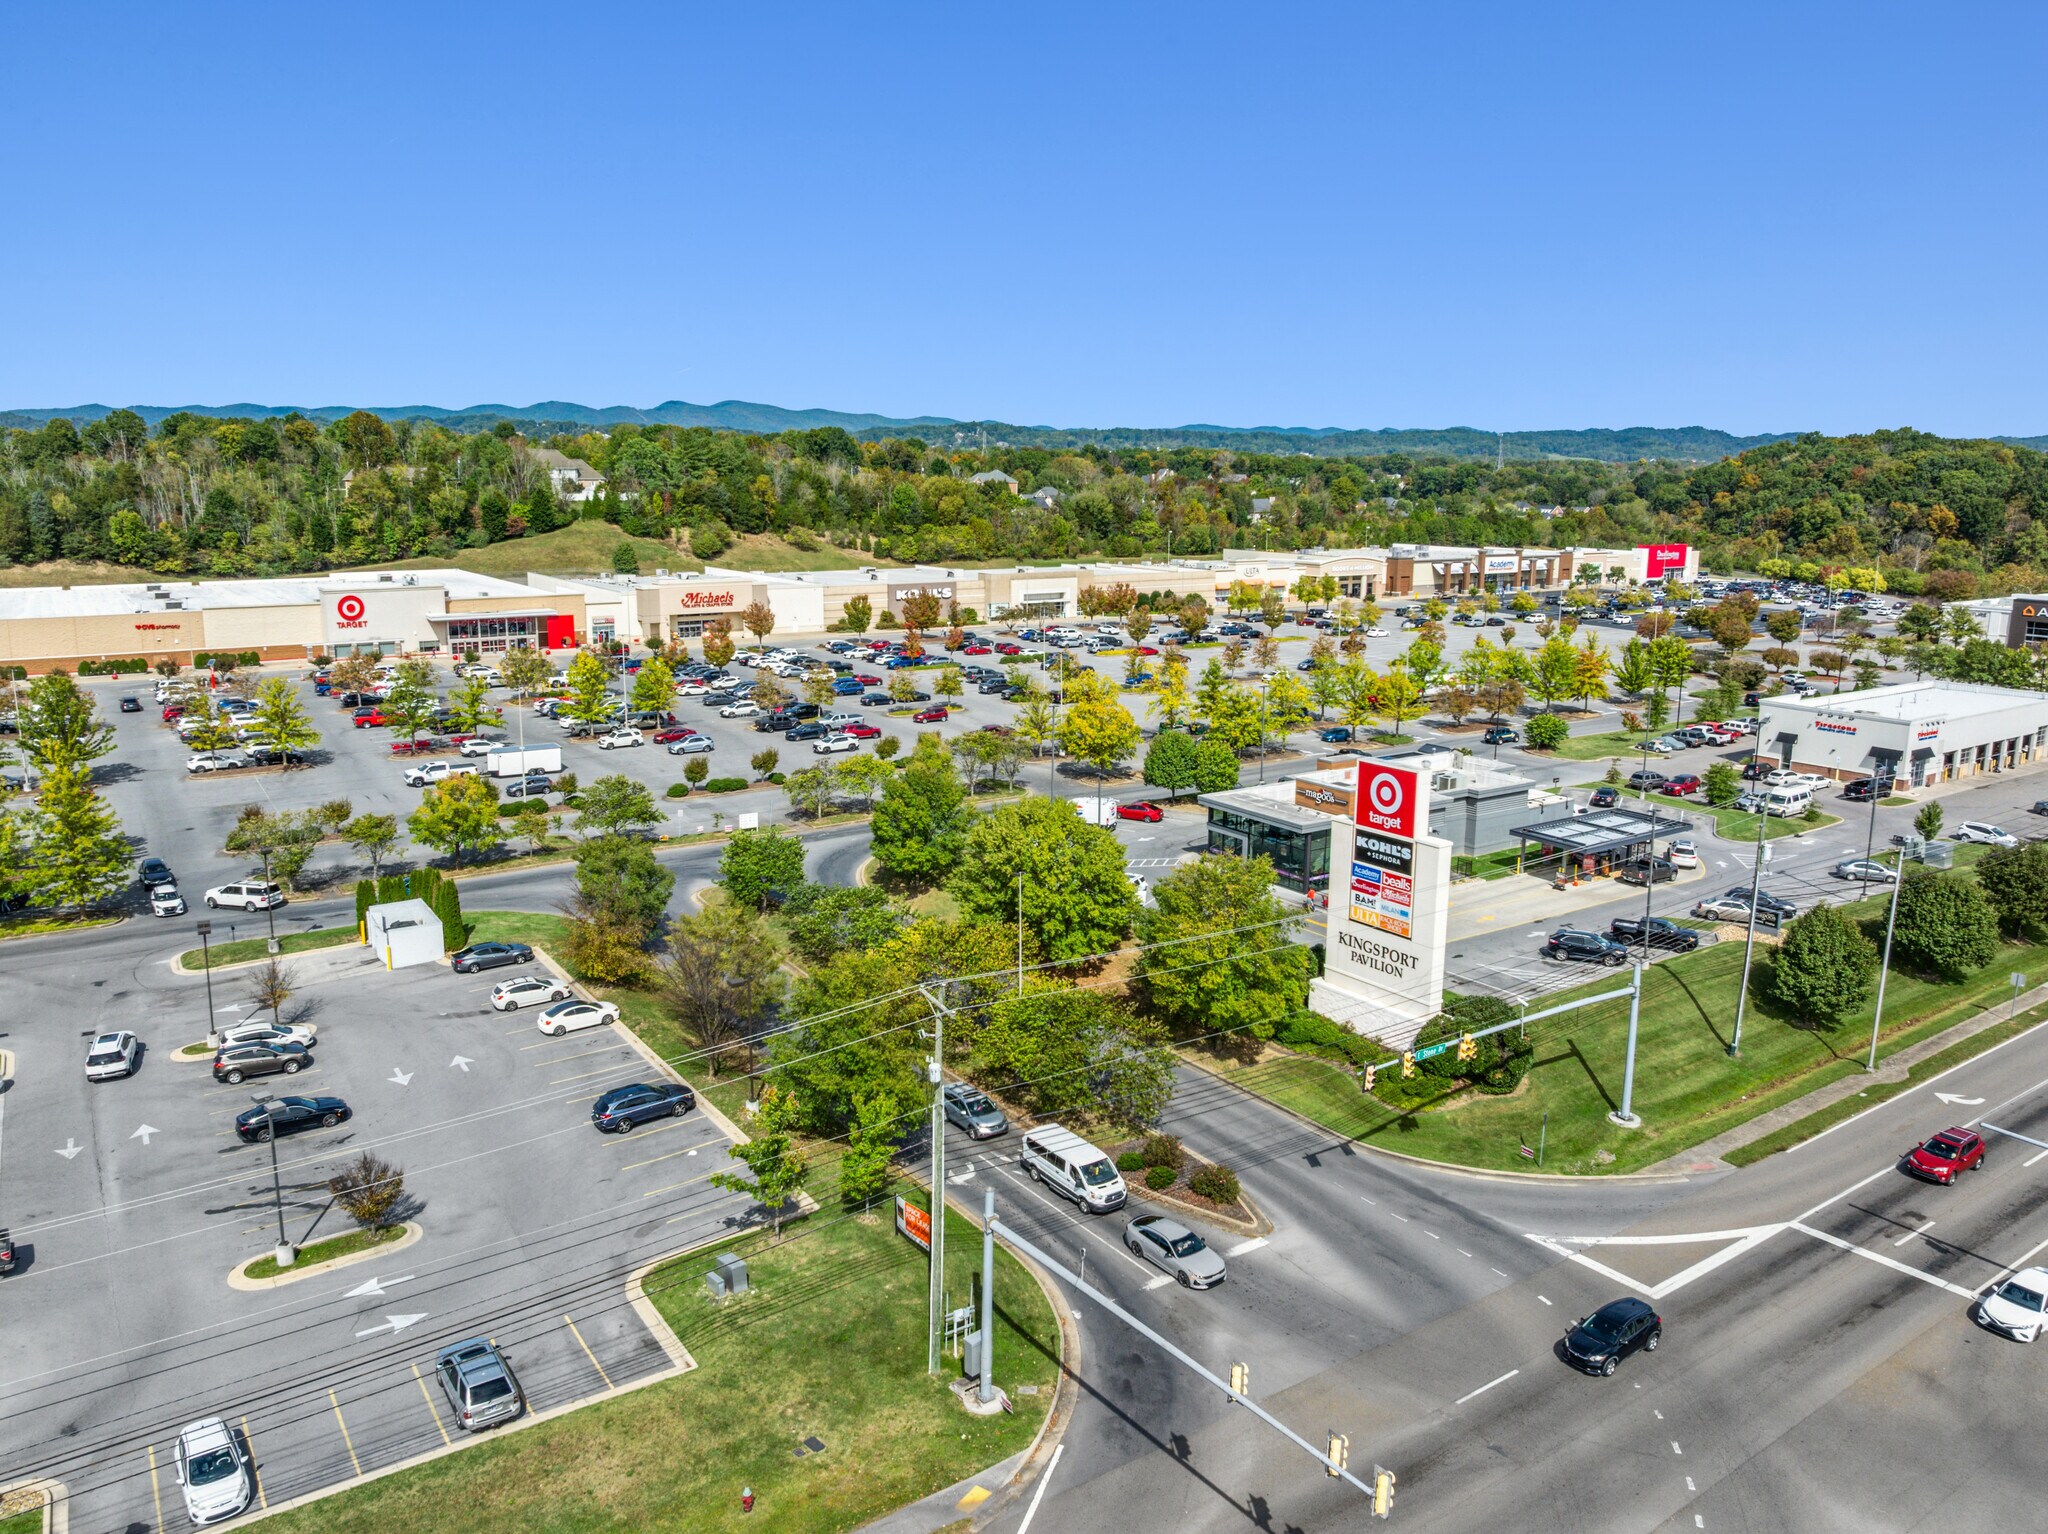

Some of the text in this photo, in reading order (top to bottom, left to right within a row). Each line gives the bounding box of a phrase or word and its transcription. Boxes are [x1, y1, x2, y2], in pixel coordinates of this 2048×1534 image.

[681, 590, 734, 605] Michaels
[336, 620, 368, 629] TARGET
[1815, 720, 1857, 732] Firestone
[1369, 810, 1402, 829] target
[1356, 836, 1412, 860] KOHL'S
[1372, 852, 1401, 865] SEPHORA
[1354, 865, 1380, 879] Academy
[1383, 873, 1411, 891] bealls
[1355, 893, 1376, 906] BAM!
[1350, 906, 1378, 927] ULTA
[1339, 931, 1419, 970] KINGSPORT
[1351, 950, 1404, 978] PAVILION
[906, 1211, 916, 1222] FOR
